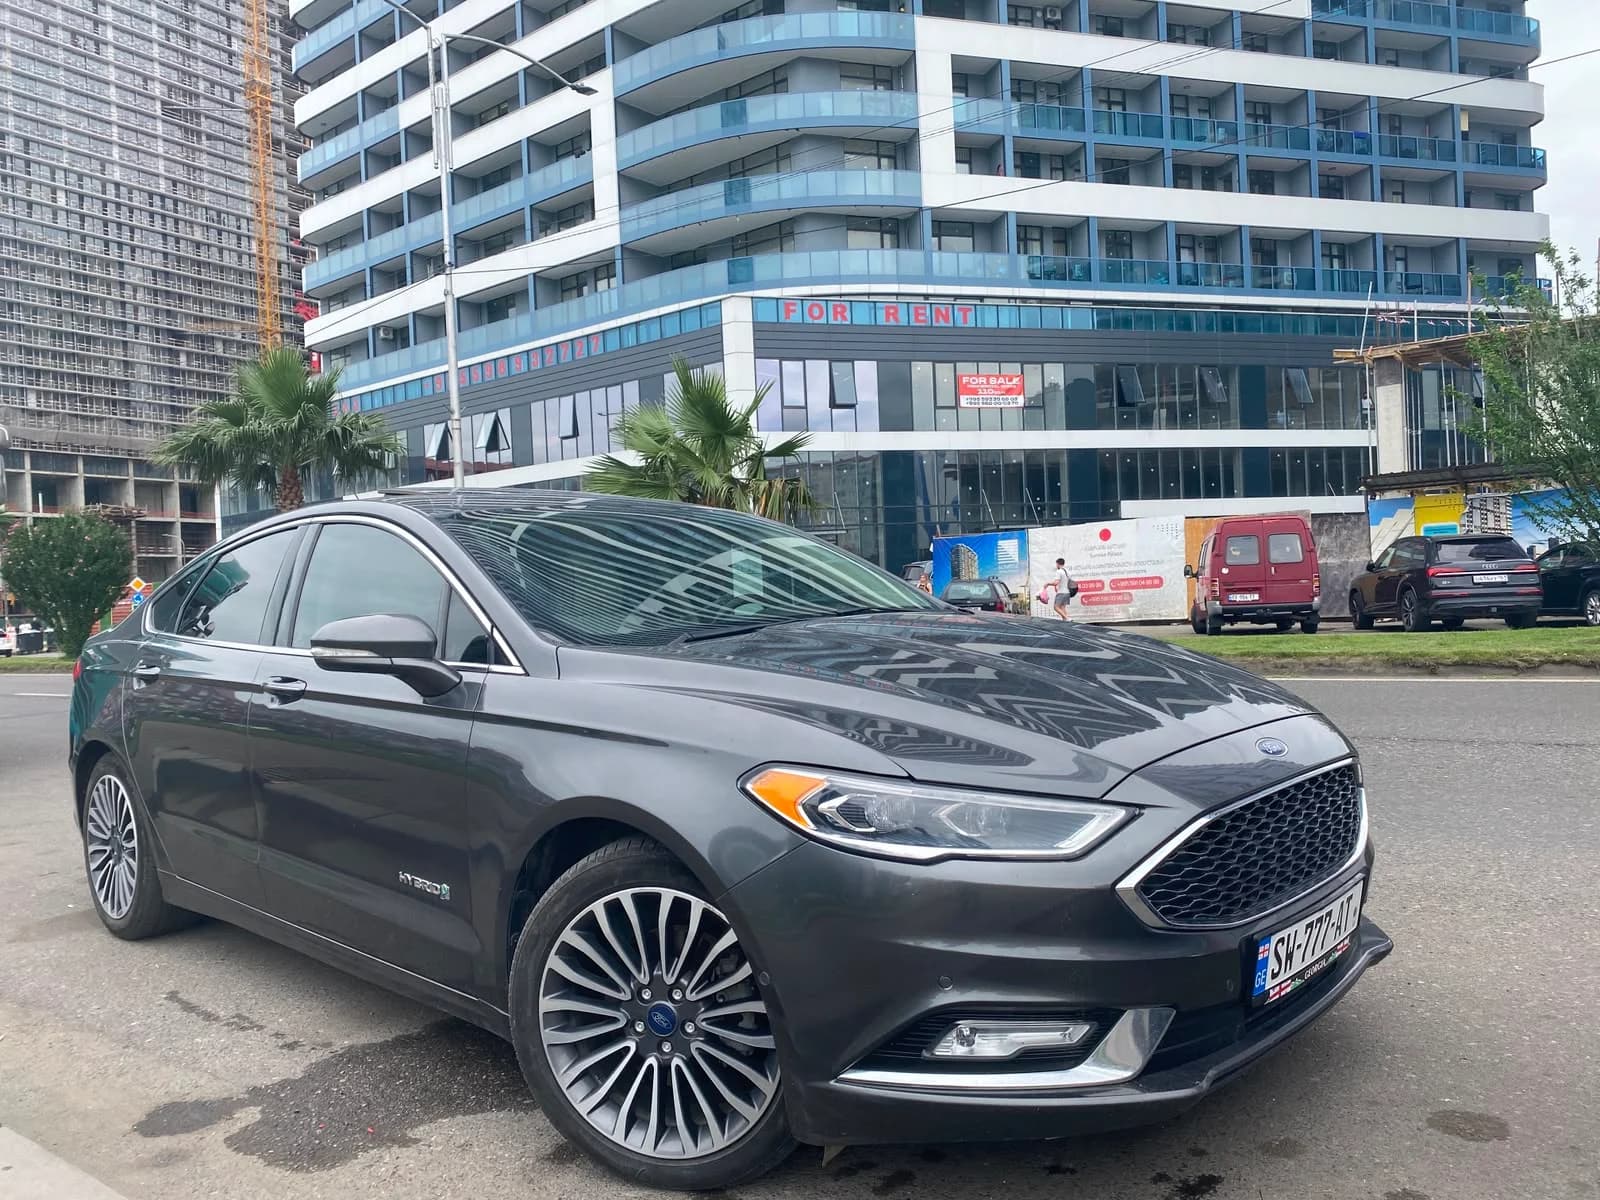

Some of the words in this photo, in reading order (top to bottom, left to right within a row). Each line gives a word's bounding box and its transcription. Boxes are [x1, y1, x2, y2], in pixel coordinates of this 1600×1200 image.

[784, 302, 848, 321] FOR
[884, 305, 973, 325] RENT
[962, 377, 987, 385] FOR
[989, 377, 1020, 385] SALE
[398, 871, 441, 895] HYBRID
[1255, 968, 1267, 988] GE
[1270, 893, 1354, 981] SW-777-AT
